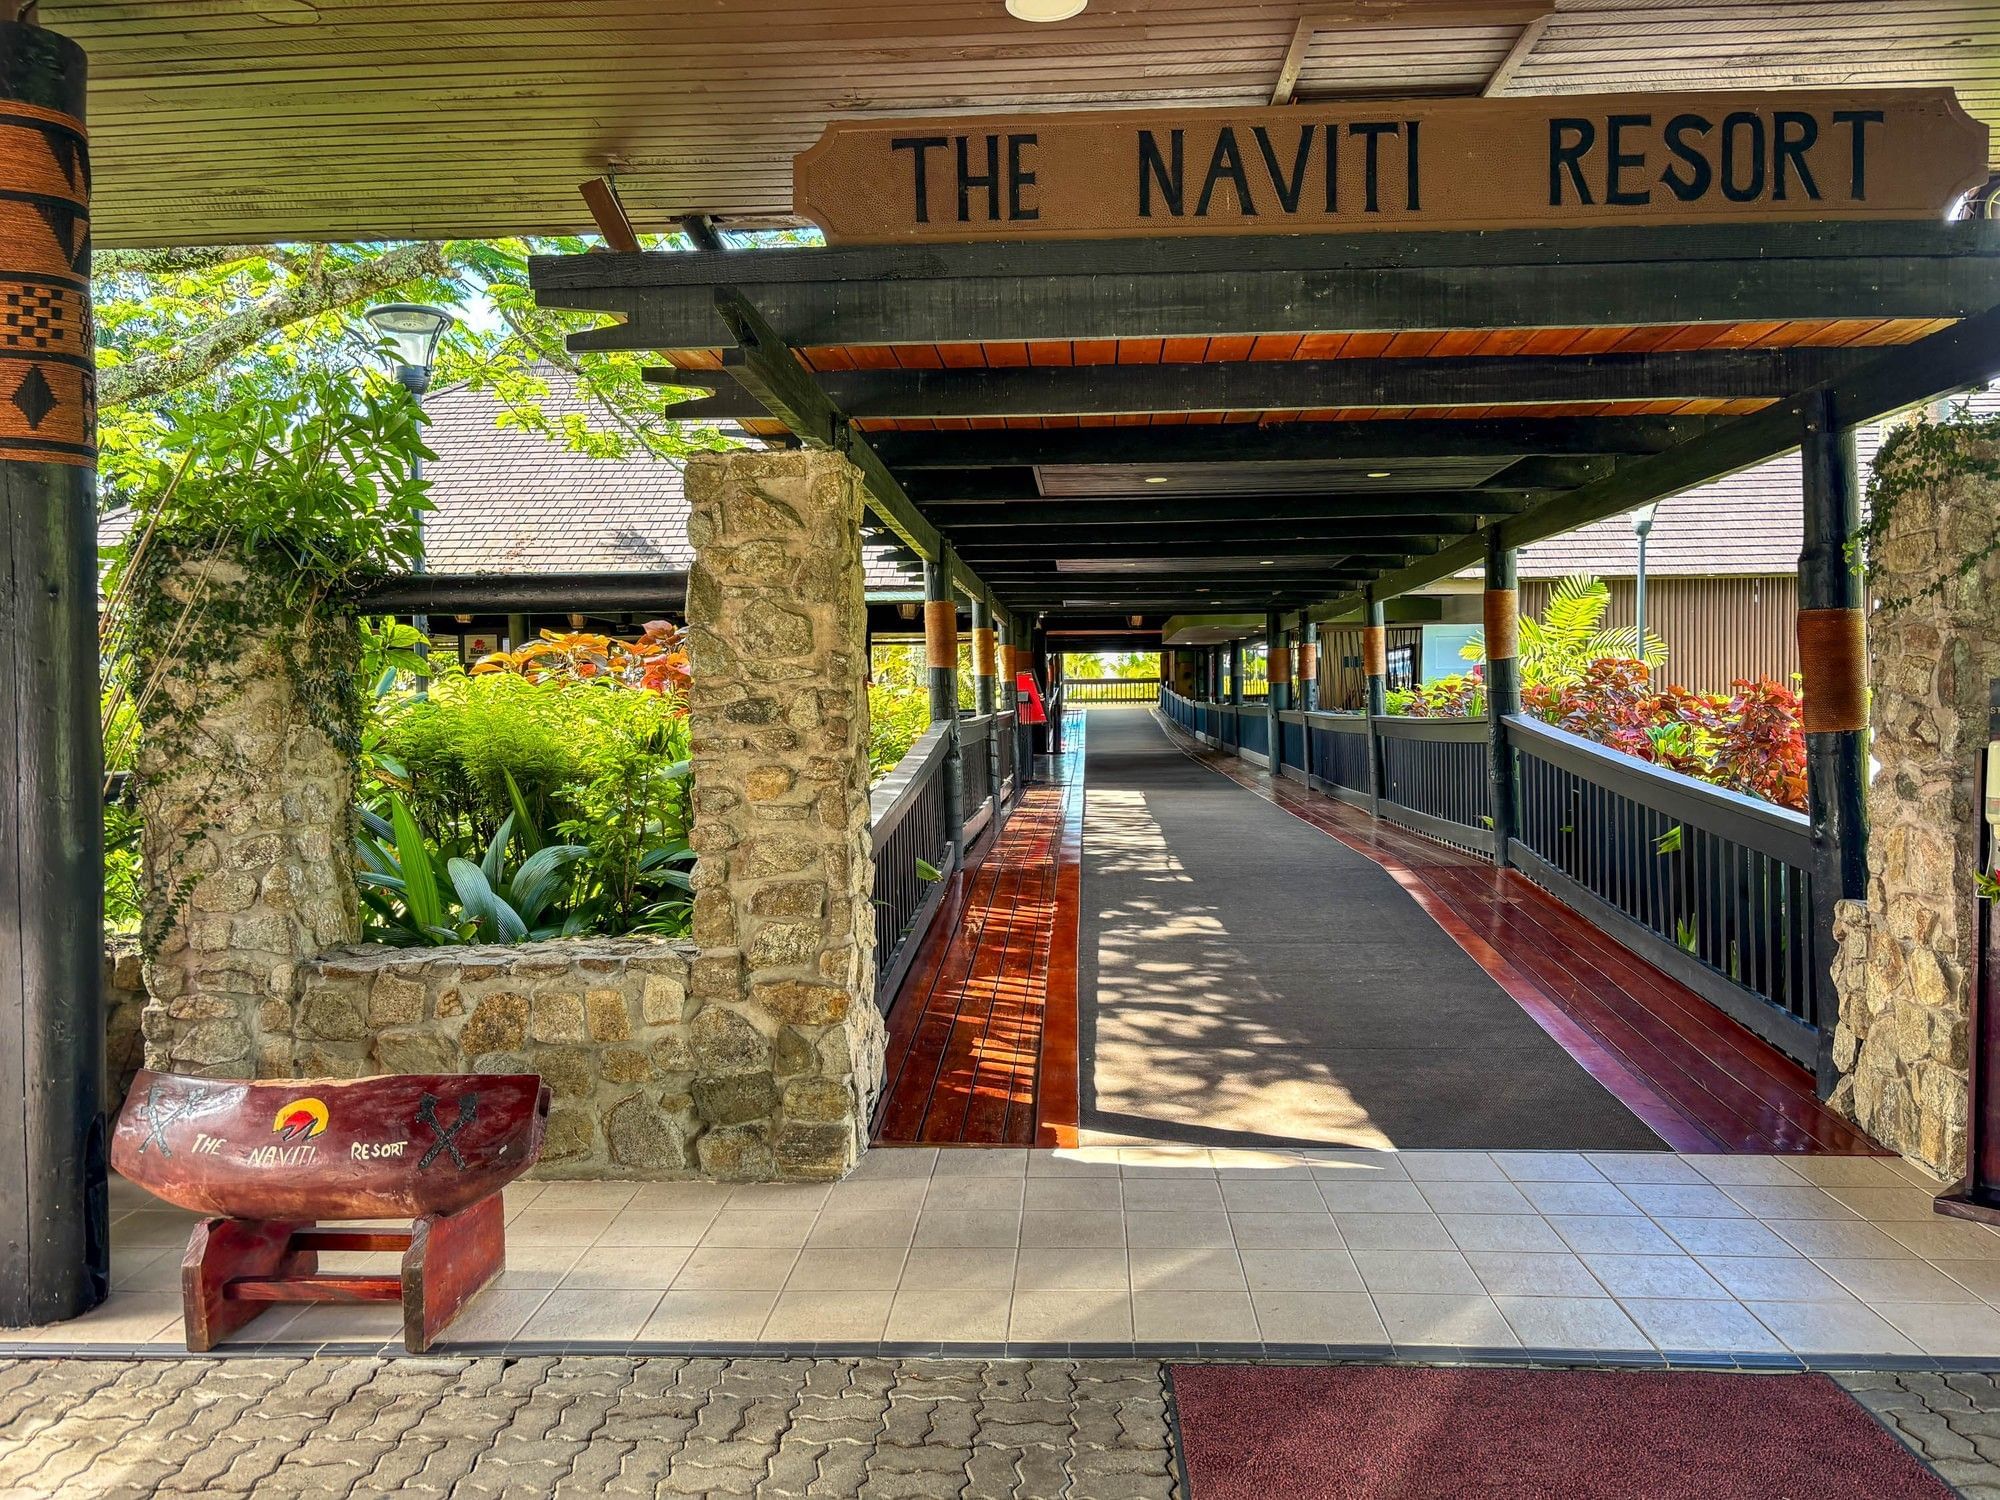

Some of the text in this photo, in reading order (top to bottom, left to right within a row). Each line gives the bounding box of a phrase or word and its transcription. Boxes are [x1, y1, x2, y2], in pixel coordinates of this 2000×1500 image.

[891, 110, 1884, 223] THE NAVITI RESORT
[191, 1133, 408, 1168] THE NAVITI RESORT
